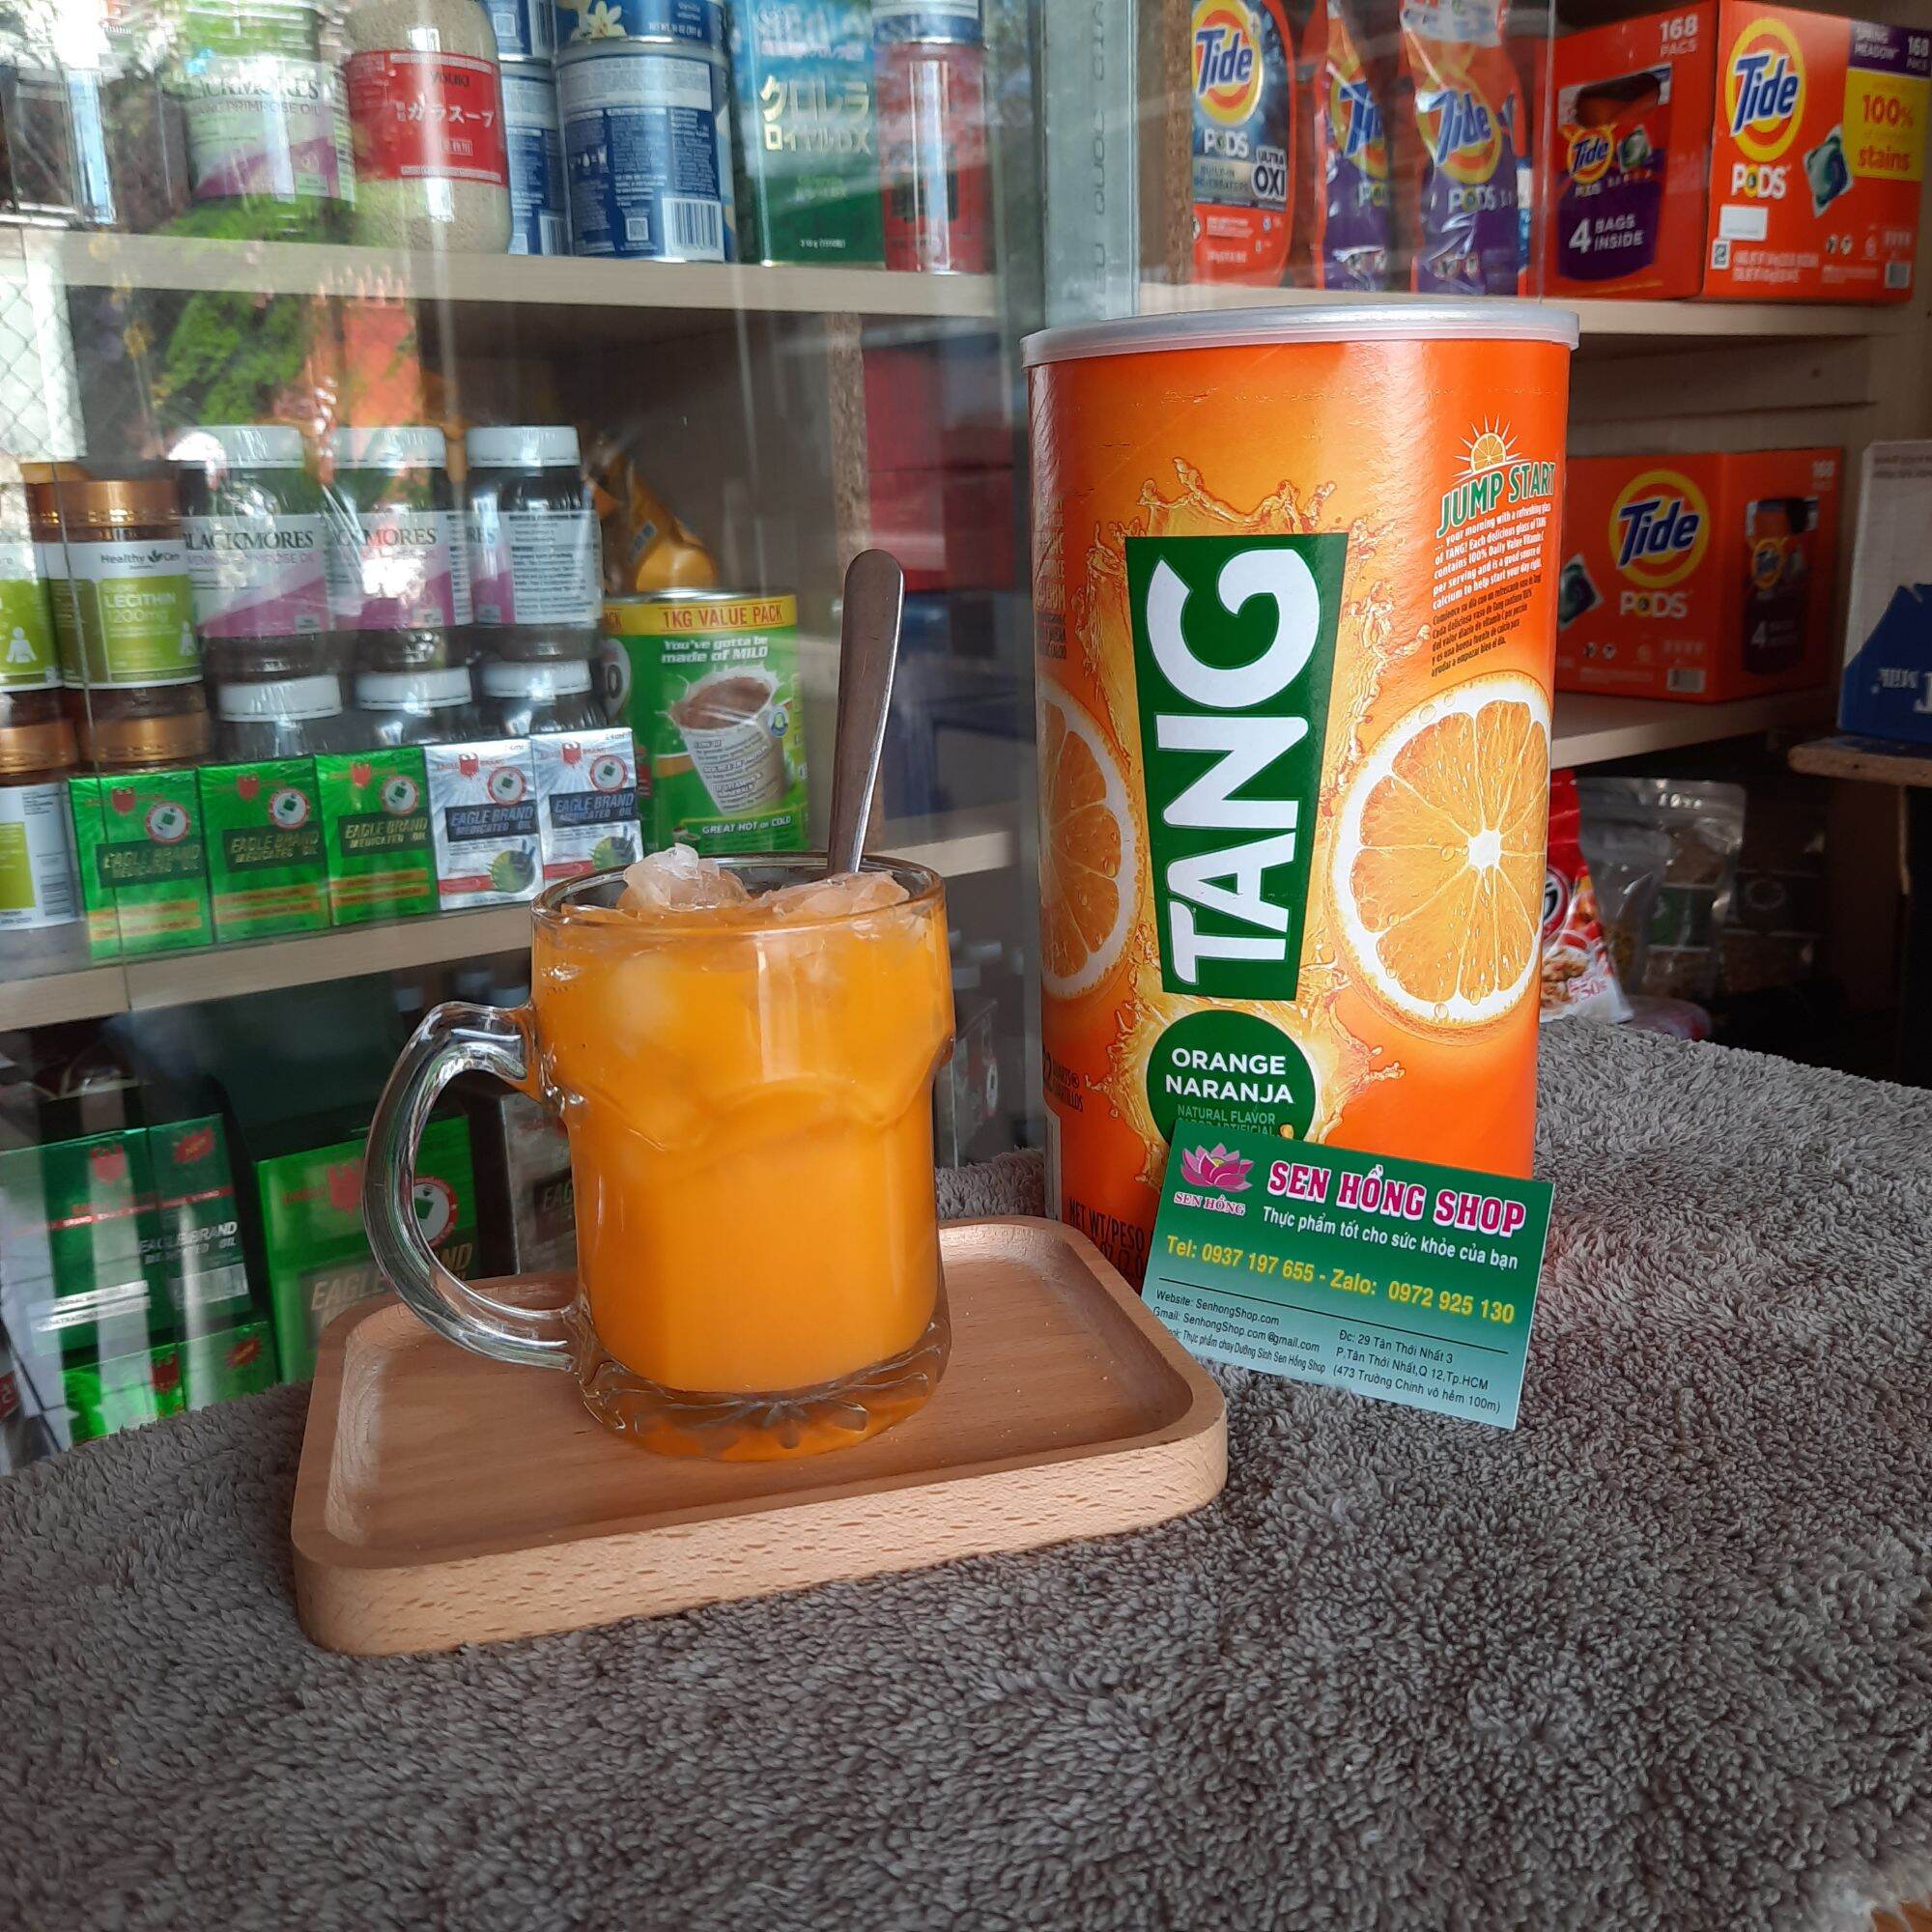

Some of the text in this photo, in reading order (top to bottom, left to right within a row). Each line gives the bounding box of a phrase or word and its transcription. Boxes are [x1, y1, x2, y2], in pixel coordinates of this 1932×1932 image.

[1660, 14, 1698, 42] 168
[1196, 28, 1253, 97] Tide
[1729, 49, 1800, 136] Tide
[1862, 94, 1914, 128] 100%
[1428, 89, 1492, 165] Tide
[1203, 128, 1250, 158] PODS
[1573, 138, 1608, 176] Tide
[1858, 145, 1910, 170] stains
[1254, 164, 1286, 196] OXI
[1731, 163, 1786, 199] PODS
[1569, 213, 1635, 254] 4 BAGS
[1594, 230, 1644, 251] INSIDE
[1436, 461, 1556, 539] JUMP START
[1446, 530, 1464, 546] your
[1465, 518, 1495, 537] morning
[1496, 512, 1511, 525] with
[1616, 495, 1700, 570] Tide
[100, 553, 145, 565] Healthy
[1435, 552, 1443, 565] of
[1469, 535, 1486, 550] Each
[1435, 557, 1466, 580] contains
[1489, 542, 1505, 556] Daily
[1433, 582, 1446, 597] per
[1448, 569, 1477, 588] serving
[1478, 560, 1492, 575] and
[1504, 551, 1520, 566] good
[1433, 589, 1463, 611] calcium
[1464, 584, 1472, 595] to
[1473, 577, 1490, 591] help
[1491, 570, 1506, 583] start
[1619, 591, 1688, 619] PODS
[698, 609, 747, 627] VALUE
[753, 604, 782, 624] PACK
[661, 651, 707, 664] made
[711, 649, 730, 662] of
[664, 636, 769, 651] You've gotta be
[1146, 548, 1321, 983] TANG
[451, 806, 535, 826] EAGLE BRAND
[555, 792, 635, 814] EAGLE BRAND
[559, 807, 633, 822] MEDICATED OIL
[345, 816, 428, 839] EAGLE BRAND
[350, 832, 427, 848] MEDICATED OIL
[455, 822, 510, 836] MEDICATED
[702, 820, 734, 835] GREAT
[738, 819, 757, 832] HOT
[771, 815, 792, 827] COLD
[231, 830, 320, 854] EAGLE BRAND
[1171, 1047, 1287, 1075] ORANGE
[1165, 1074, 1294, 1104] NARANJA
[1177, 1104, 1228, 1122] NATURAL
[1231, 1110, 1276, 1125] FLAVOR
[1174, 1192, 1246, 1216] SEN HỒNG
[1267, 1160, 1526, 1237] SEN HỒNG SHOP
[1068, 1197, 1145, 1253] NET WT/PESO
[1264, 1206, 1518, 1270] Thực phẩm tốt cho sức khỏe của bạn
[1167, 1235, 1197, 1258] Tel:
[1202, 1243, 1243, 1267] 0937
[1248, 1253, 1279, 1274] 197
[1282, 1260, 1315, 1283] 655
[1330, 1268, 1377, 1295] Zalo:
[1388, 1281, 1434, 1308] 0972
[1438, 1291, 1473, 1316] 925
[1481, 1299, 1515, 1323] 130
[1152, 1306, 1180, 1321] Gmail:
[1156, 1289, 1280, 1326] Website: SenhongShop.com
[1183, 1329, 1199, 1344] Thực
[1218, 1339, 1235, 1353] chay
[1257, 1347, 1272, 1361] Sinh
[1273, 1352, 1287, 1364] Sen
[1307, 1358, 1326, 1375] Shop
[1339, 1329, 1454, 1364] Đc: 29 Tân Thới Nhất 3
[1368, 1352, 1391, 1368] Thới
[1333, 1364, 1355, 1378] (473
[1358, 1370, 1393, 1389] Trường
[1395, 1377, 1425, 1394] Chinh
[1442, 1388, 1464, 1404] hẻm
[1468, 1395, 1501, 1414] 100m)
